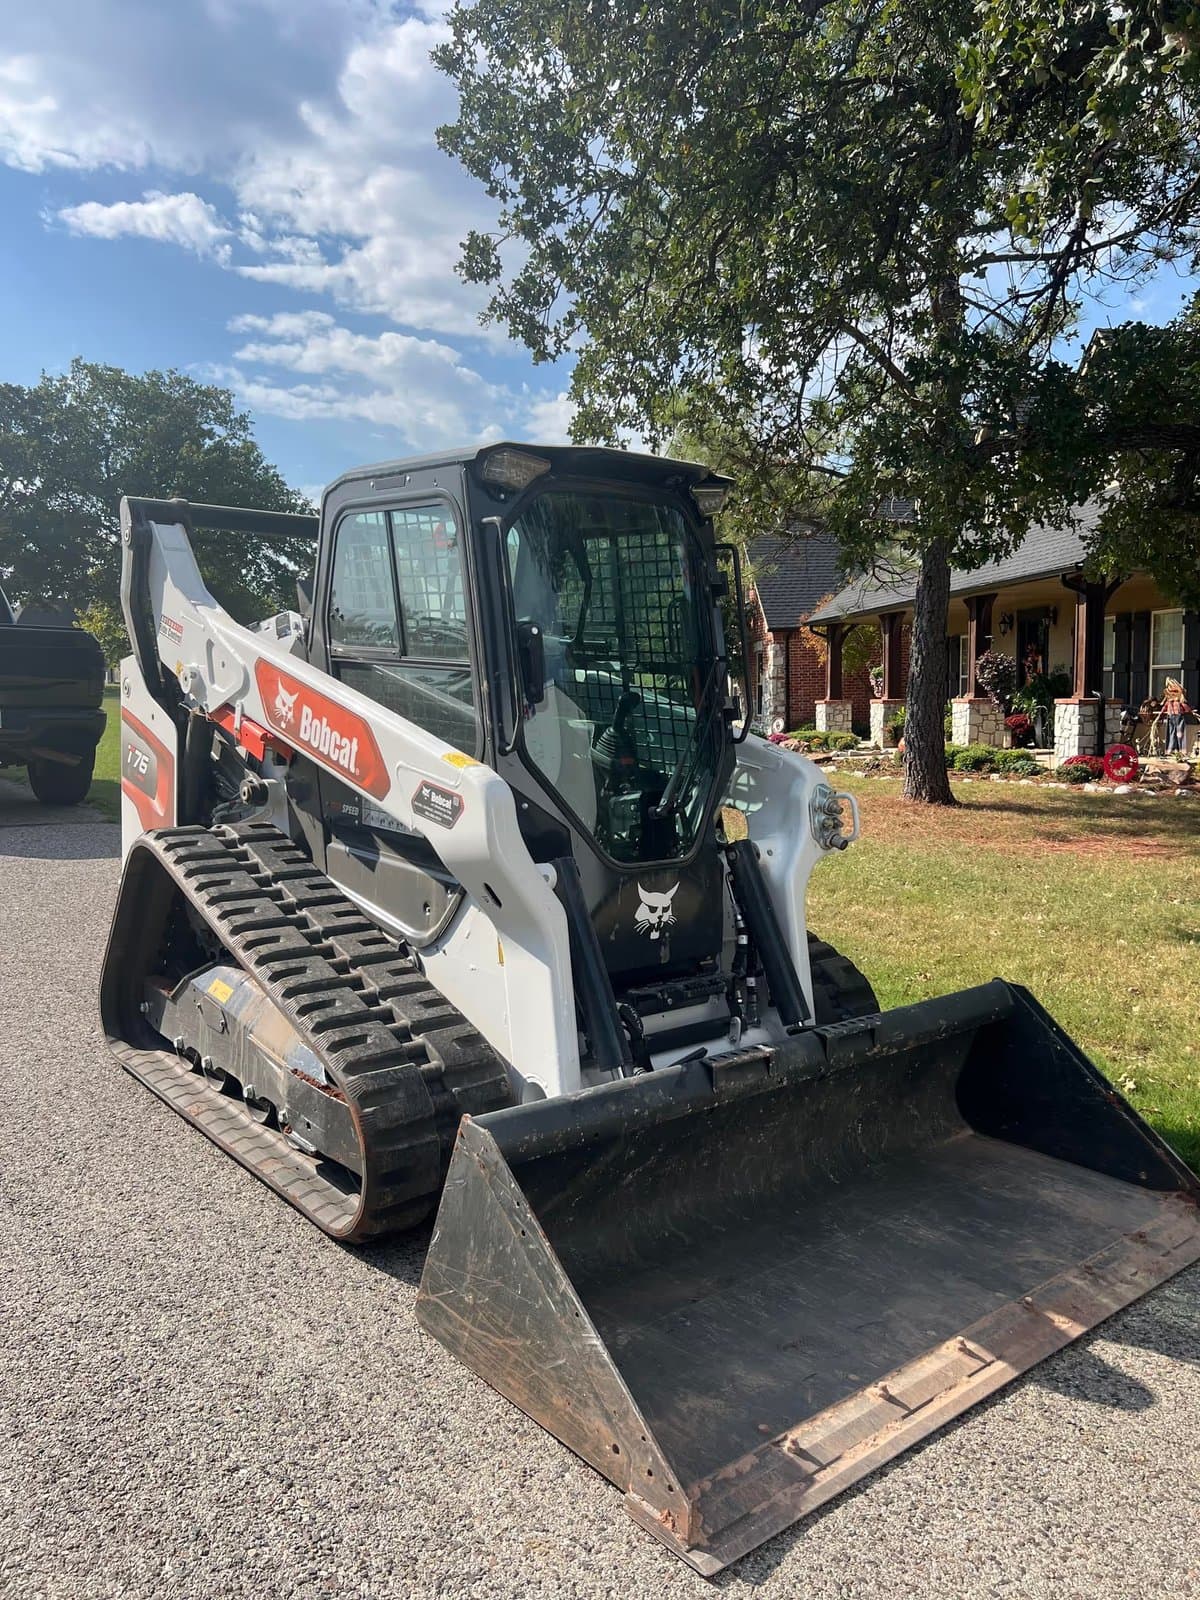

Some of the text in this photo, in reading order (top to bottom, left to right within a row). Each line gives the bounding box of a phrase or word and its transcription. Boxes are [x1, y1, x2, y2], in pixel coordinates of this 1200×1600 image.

[300, 704, 358, 773] Bobcat
[128, 745, 149, 774] T76
[342, 804, 359, 816] SPEED
